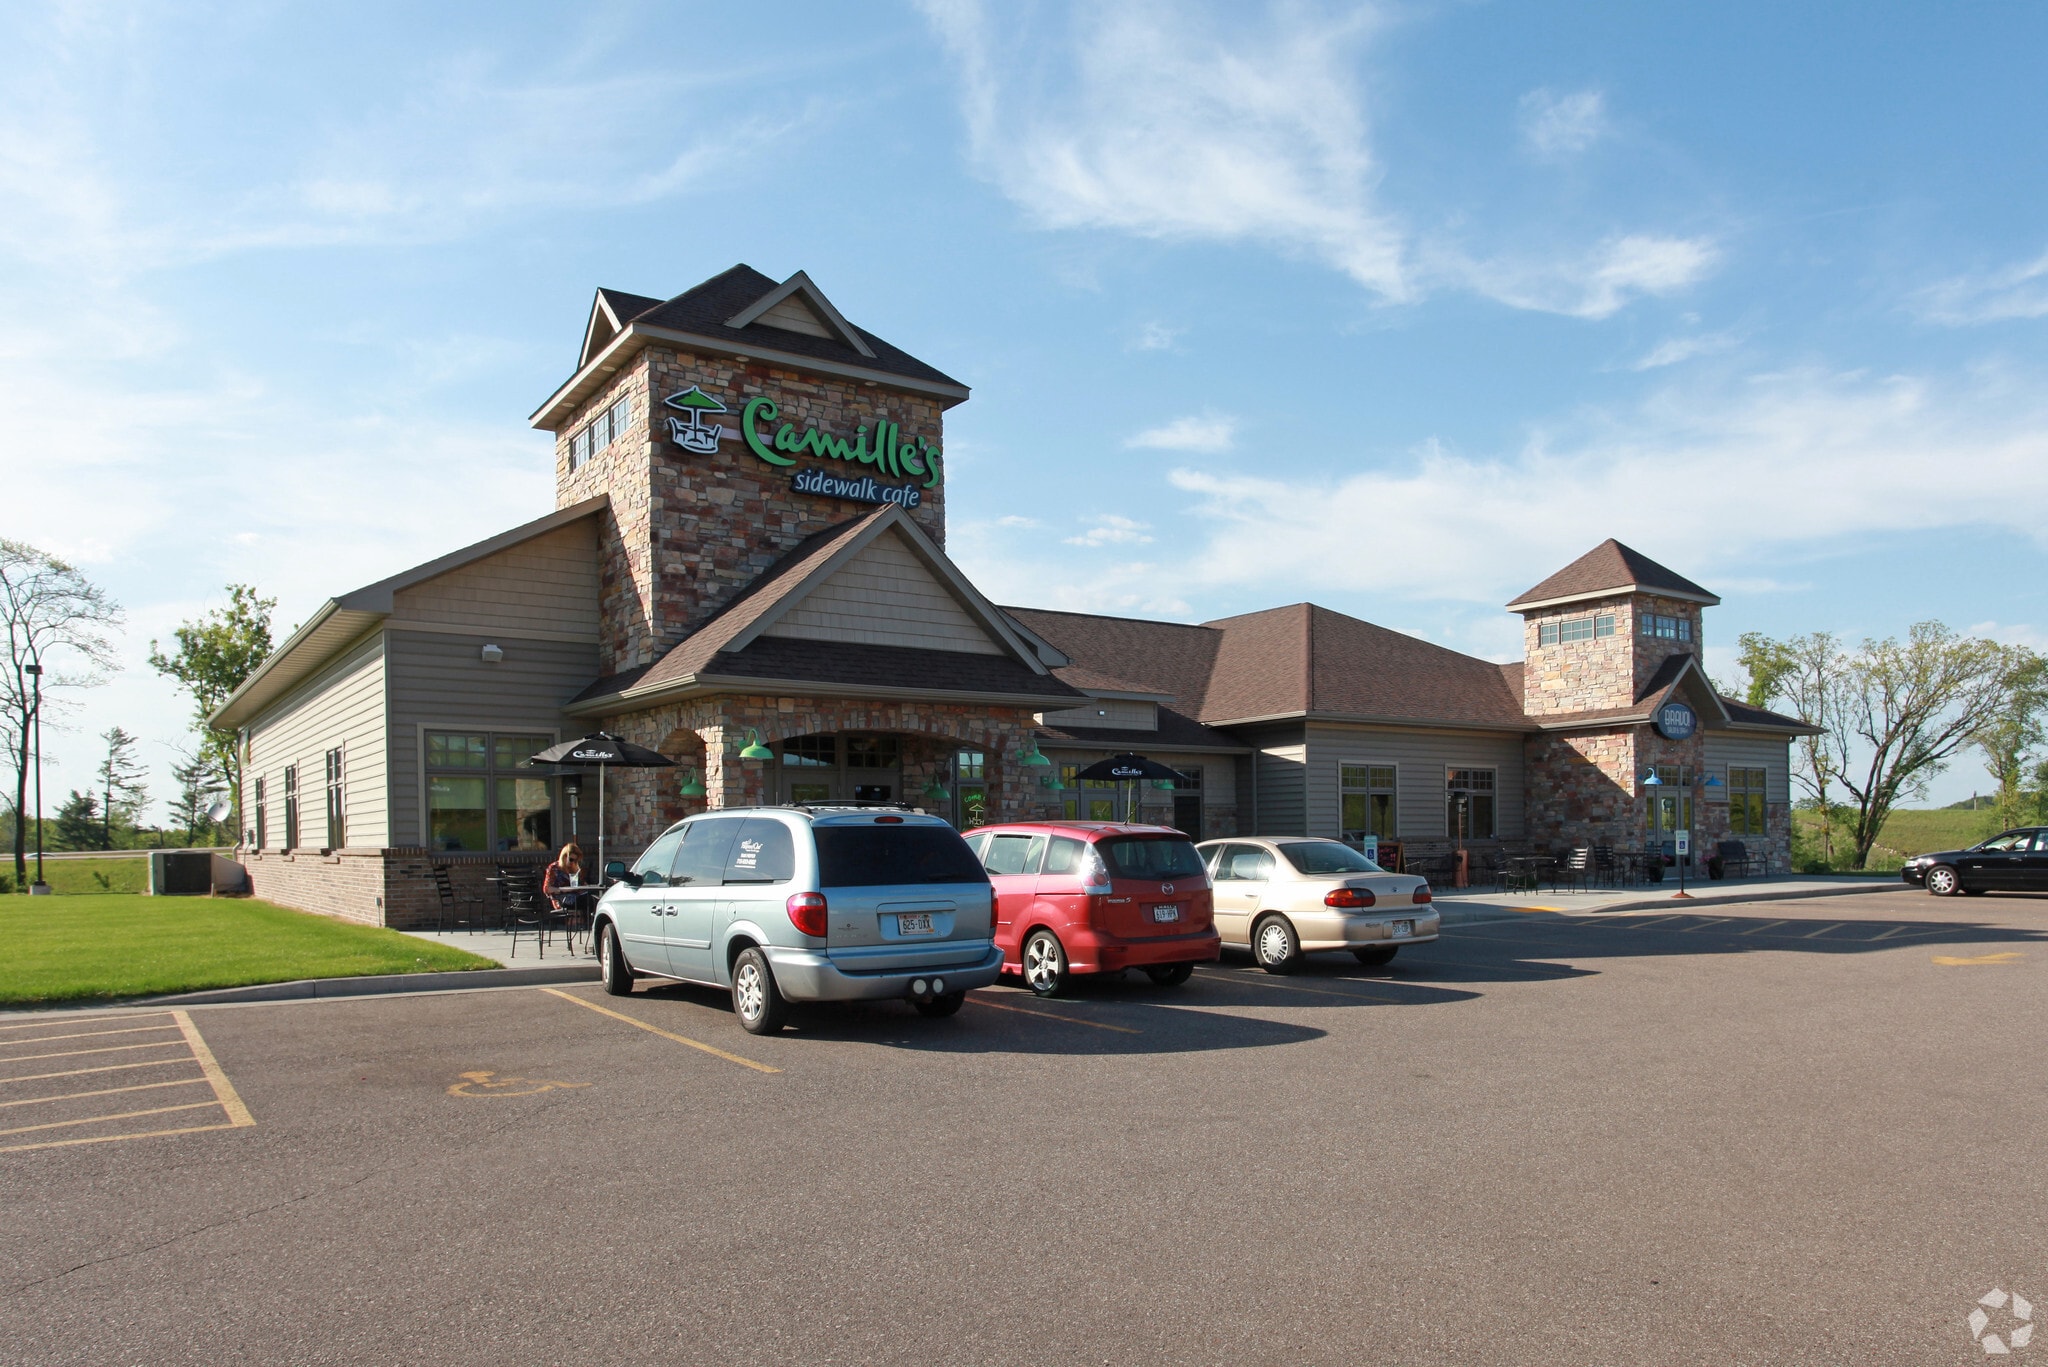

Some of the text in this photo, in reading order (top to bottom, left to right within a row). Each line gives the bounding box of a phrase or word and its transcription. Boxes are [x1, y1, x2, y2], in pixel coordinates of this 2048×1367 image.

[742, 396, 941, 489] Camille's
[795, 470, 920, 508] sidewalk cafe
